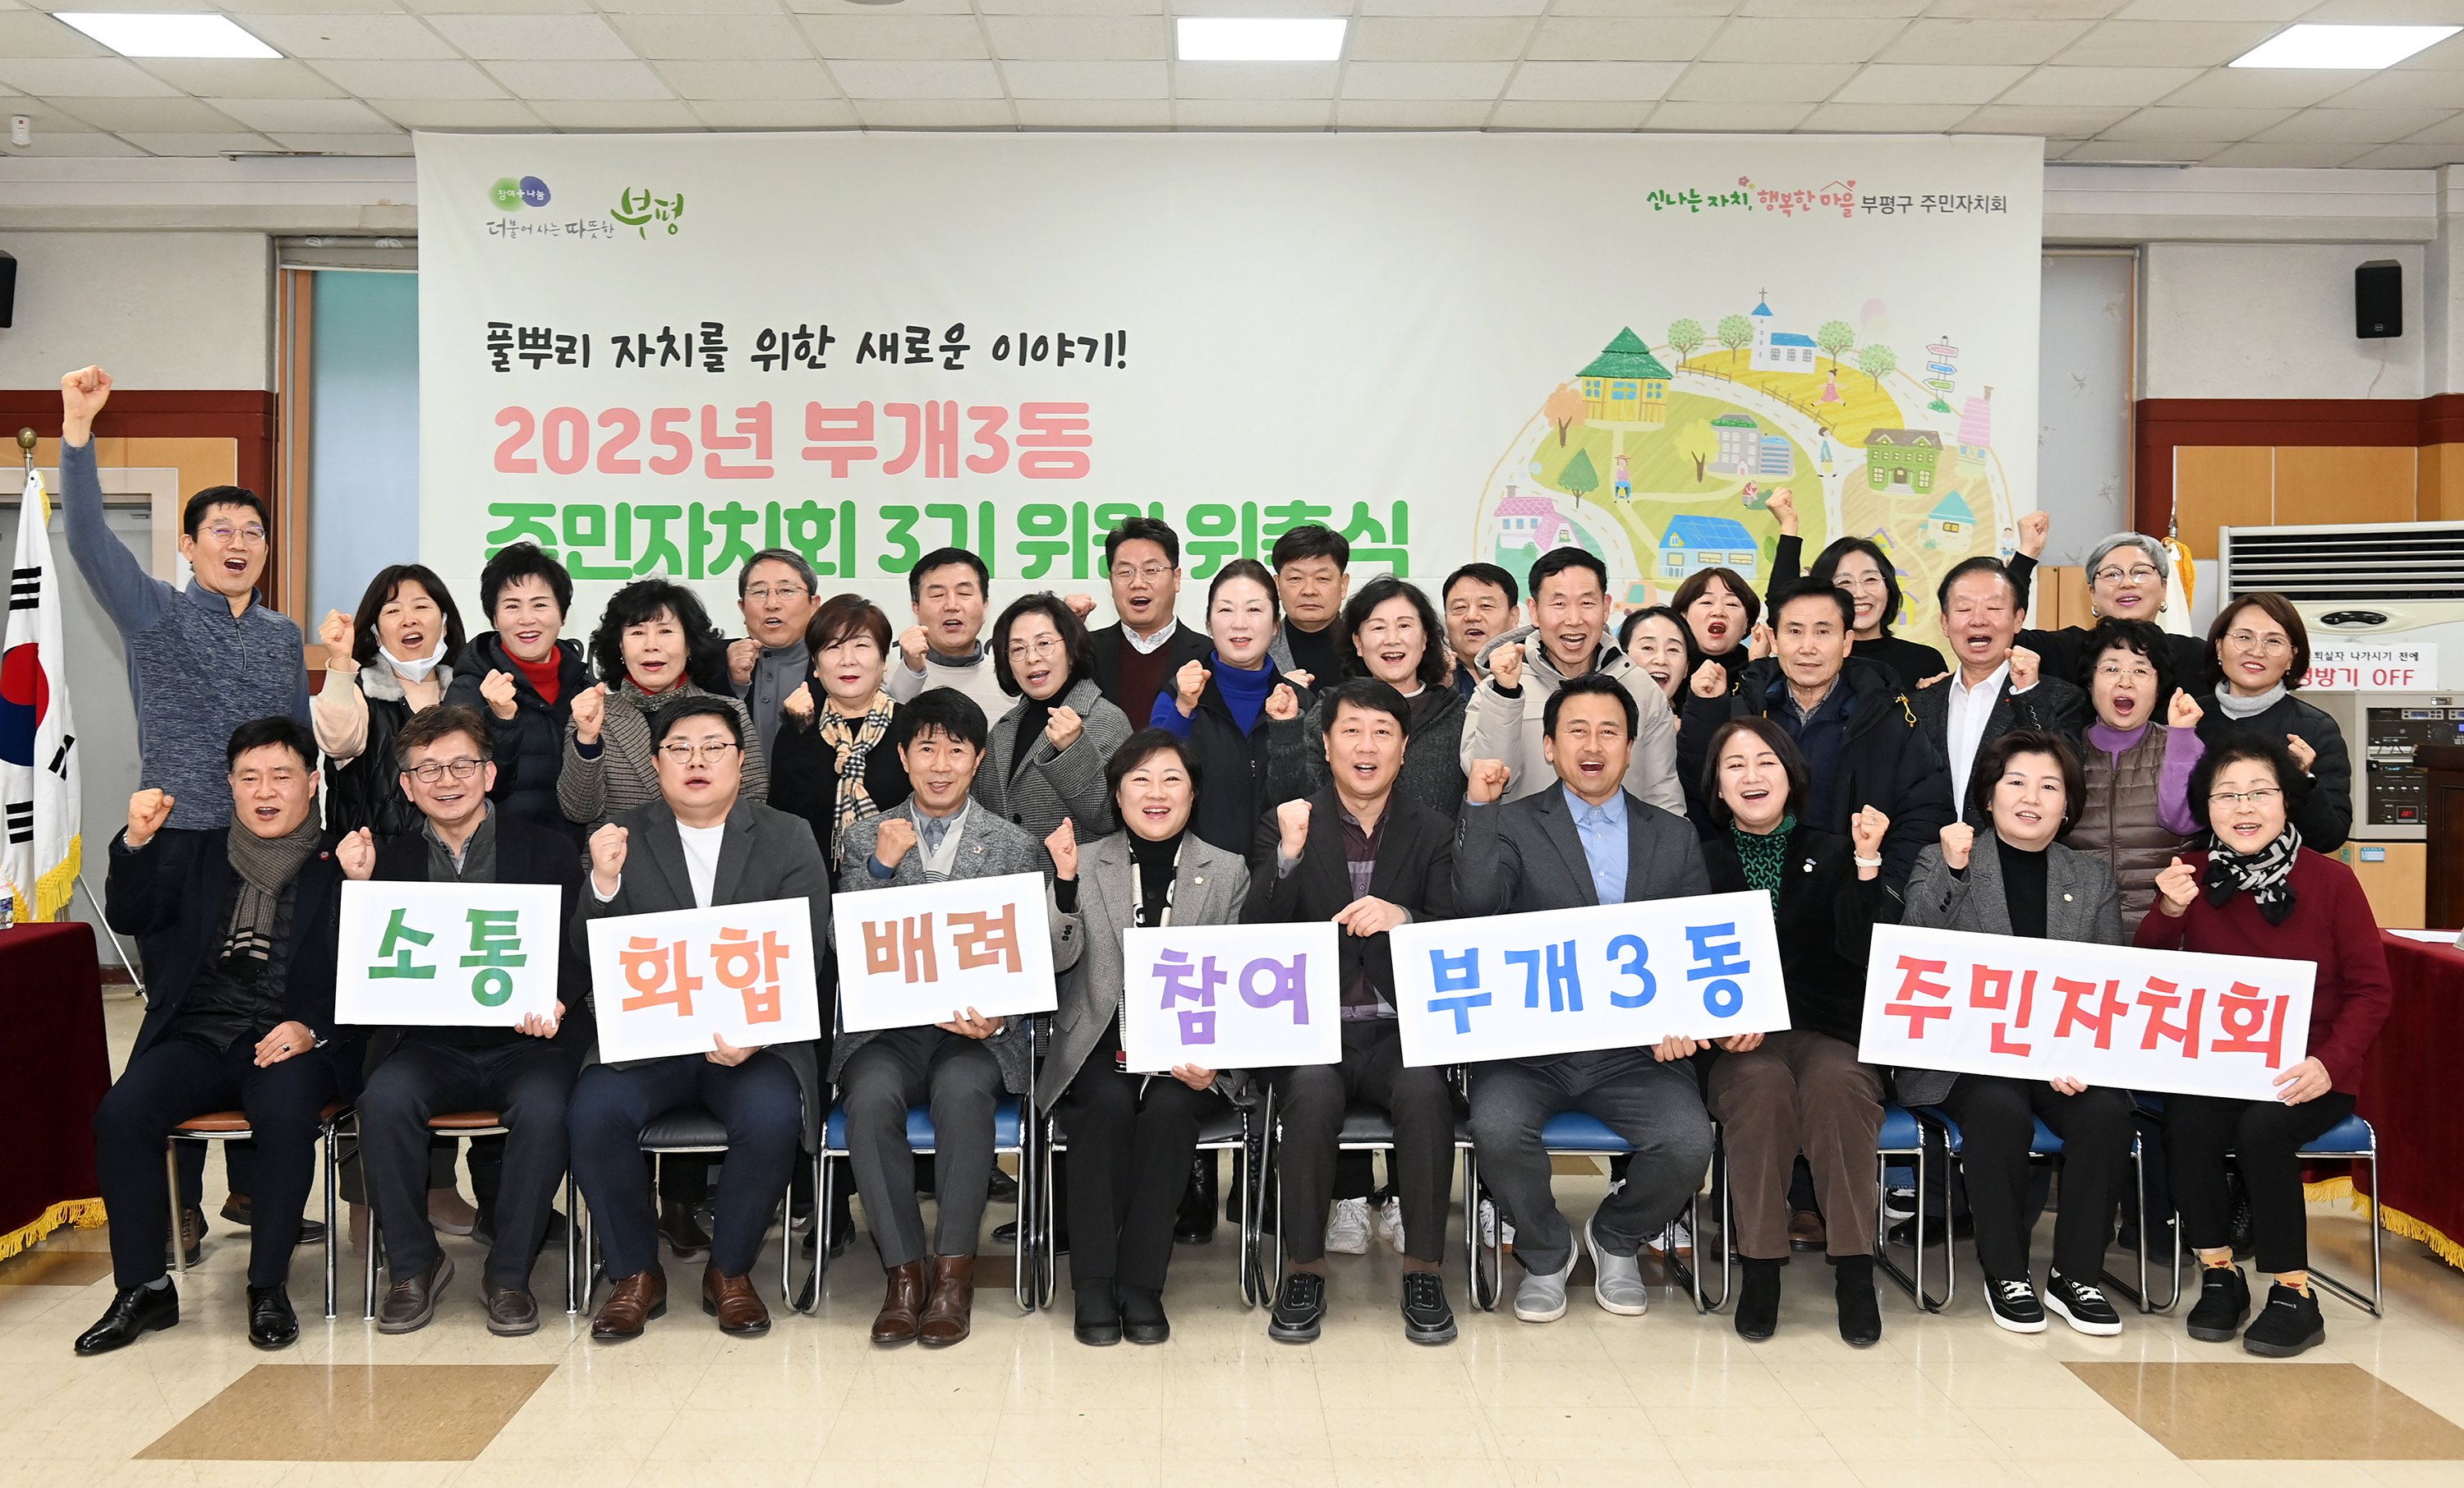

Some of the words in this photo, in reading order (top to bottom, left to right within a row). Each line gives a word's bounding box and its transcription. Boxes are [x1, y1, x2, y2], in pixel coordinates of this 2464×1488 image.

[485, 217, 532, 238] 더불어
[536, 222, 561, 237] 사는
[564, 218, 614, 239] 따뜻한
[610, 187, 683, 240] 부평
[1647, 189, 1703, 213] 신나는
[1708, 191, 1753, 211] 자치,
[1757, 189, 1817, 218] 행복한
[1819, 191, 1856, 218] 마을
[1860, 195, 1914, 215] 부평구
[1919, 194, 2007, 214] 주민자치회
[487, 321, 591, 373] 풀뿌리
[611, 321, 729, 373] 자치를
[751, 324, 836, 372] 위한
[856, 322, 971, 370] 새로운
[991, 329, 1126, 370] 이야기!
[494, 401, 775, 480] 2025년
[801, 400, 1093, 480] 부개3동
[878, 500, 995, 579] 3기
[2315, 651, 2344, 662] 퇴실자
[2351, 651, 2392, 662] 나가시기
[2399, 651, 2419, 662] 전에
[2373, 668, 2415, 686] OFF
[369, 908, 527, 1007] 소통
[618, 926, 789, 1025] 화합
[862, 902, 1023, 984] 배려
[1152, 948, 1309, 1045] 참여
[1884, 953, 2290, 1069] 주민자치회
